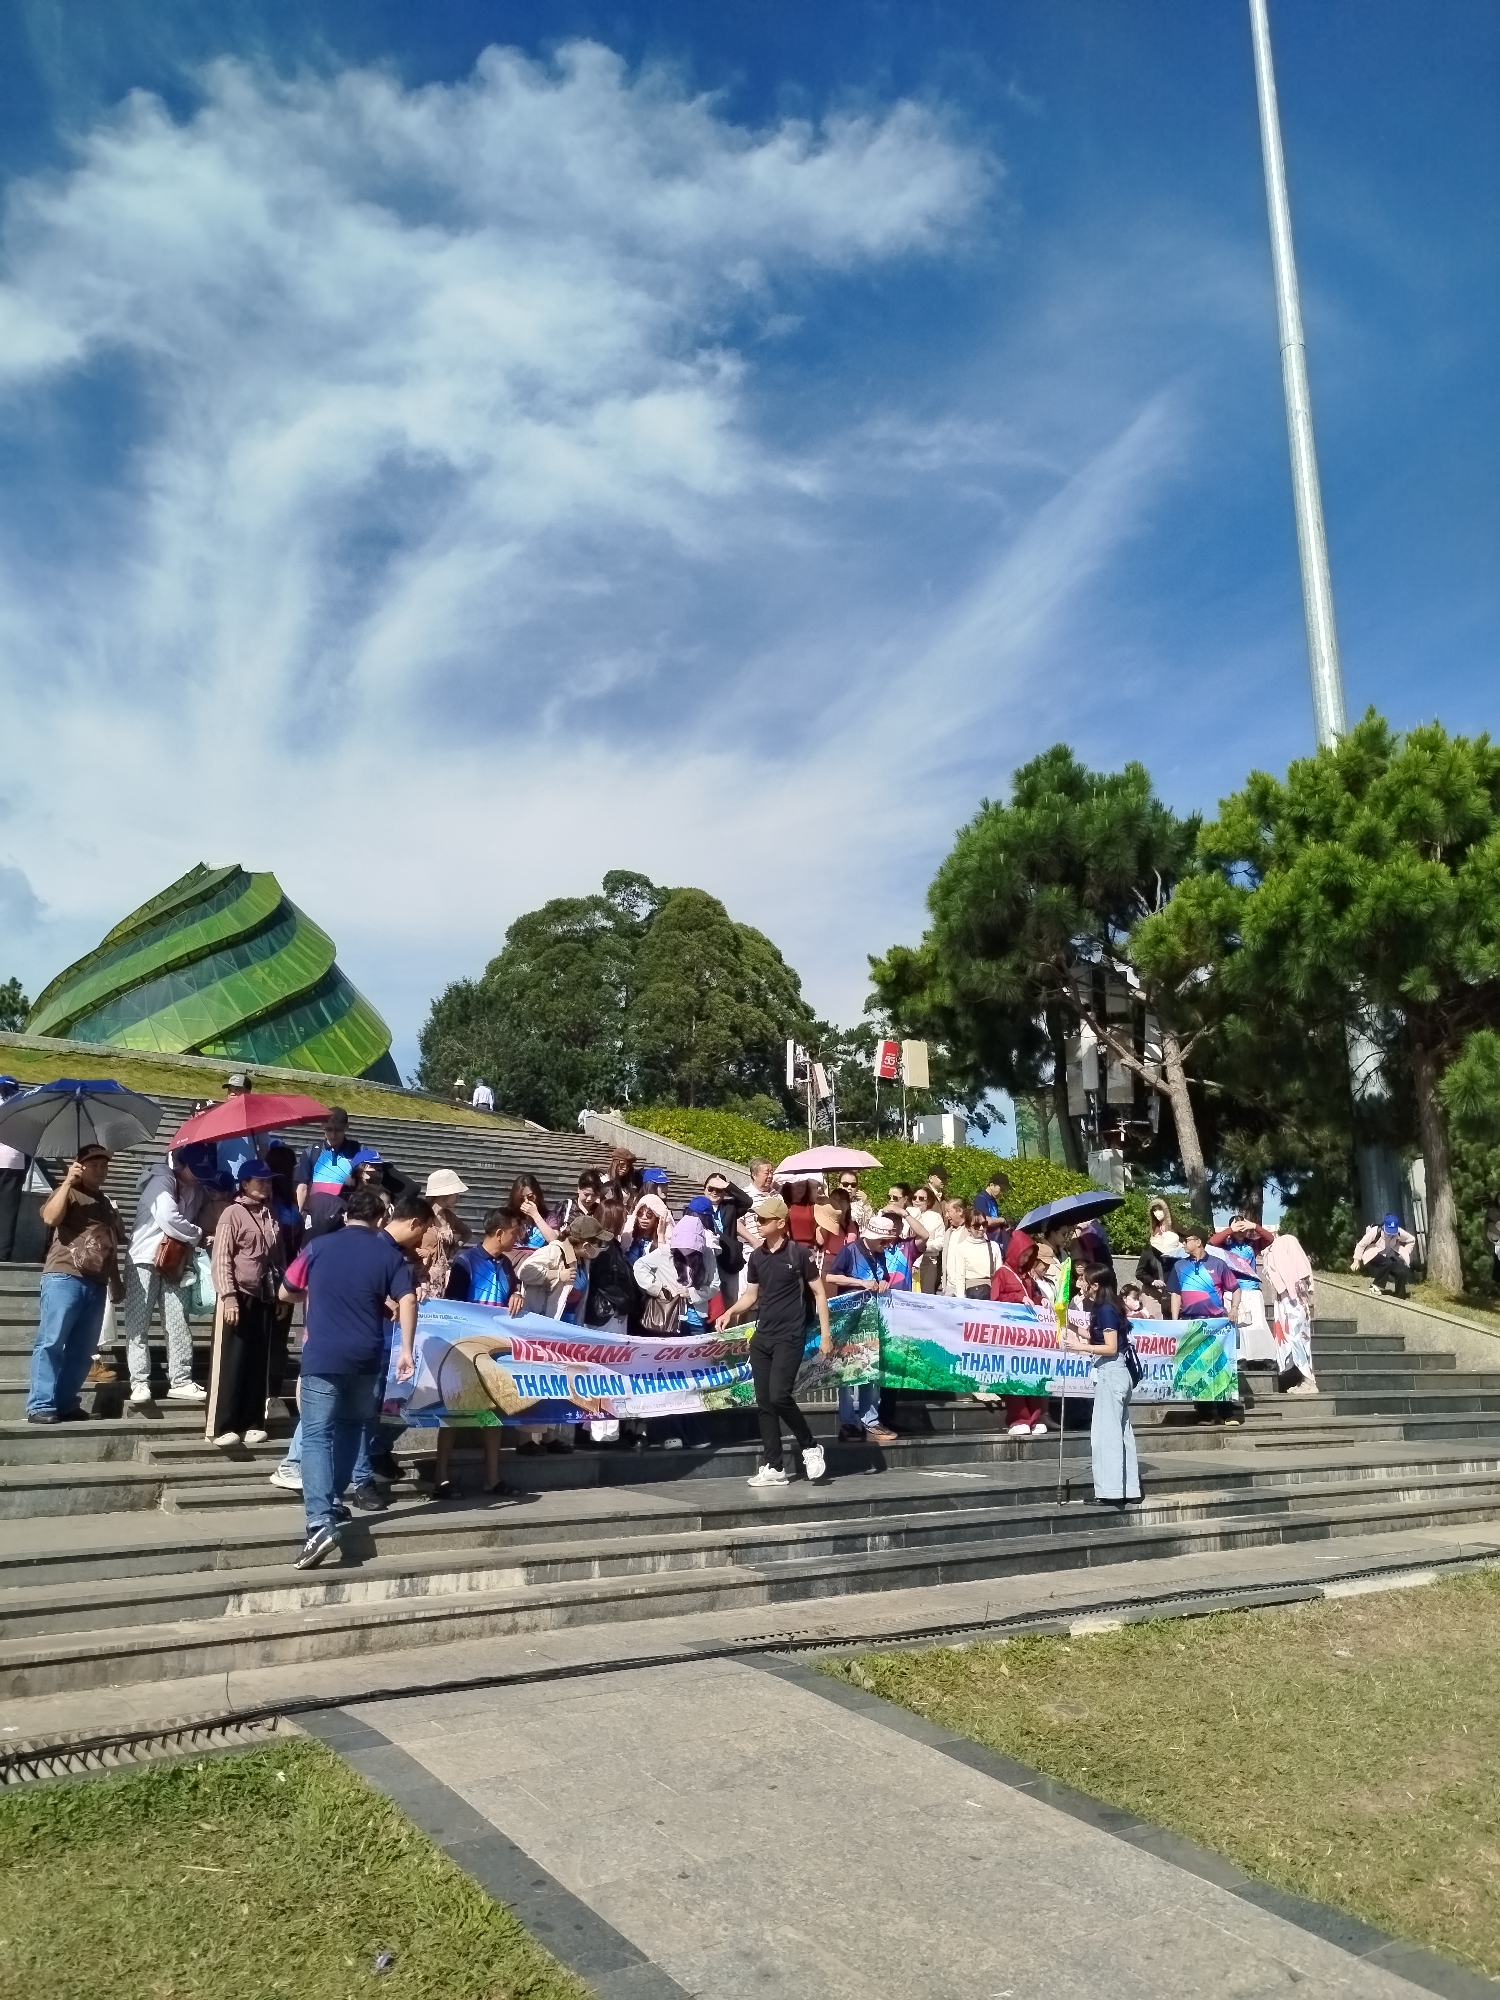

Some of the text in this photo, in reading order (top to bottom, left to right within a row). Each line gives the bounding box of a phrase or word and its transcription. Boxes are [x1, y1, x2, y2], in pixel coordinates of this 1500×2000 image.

[884, 1055, 896, 1066] 5G
[965, 1321, 1061, 1350] VIETINBANK
[1134, 1332, 1177, 1356] TRĂNG
[509, 1337, 640, 1363] VIETINBANK
[653, 1346, 690, 1361] CN
[961, 1352, 1005, 1373] THAM
[1011, 1355, 1052, 1376] QUAN
[512, 1374, 570, 1397] THAM
[574, 1374, 626, 1398] QUAN
[629, 1367, 689, 1395] KHÁM
[691, 1361, 732, 1388] PHÁ
